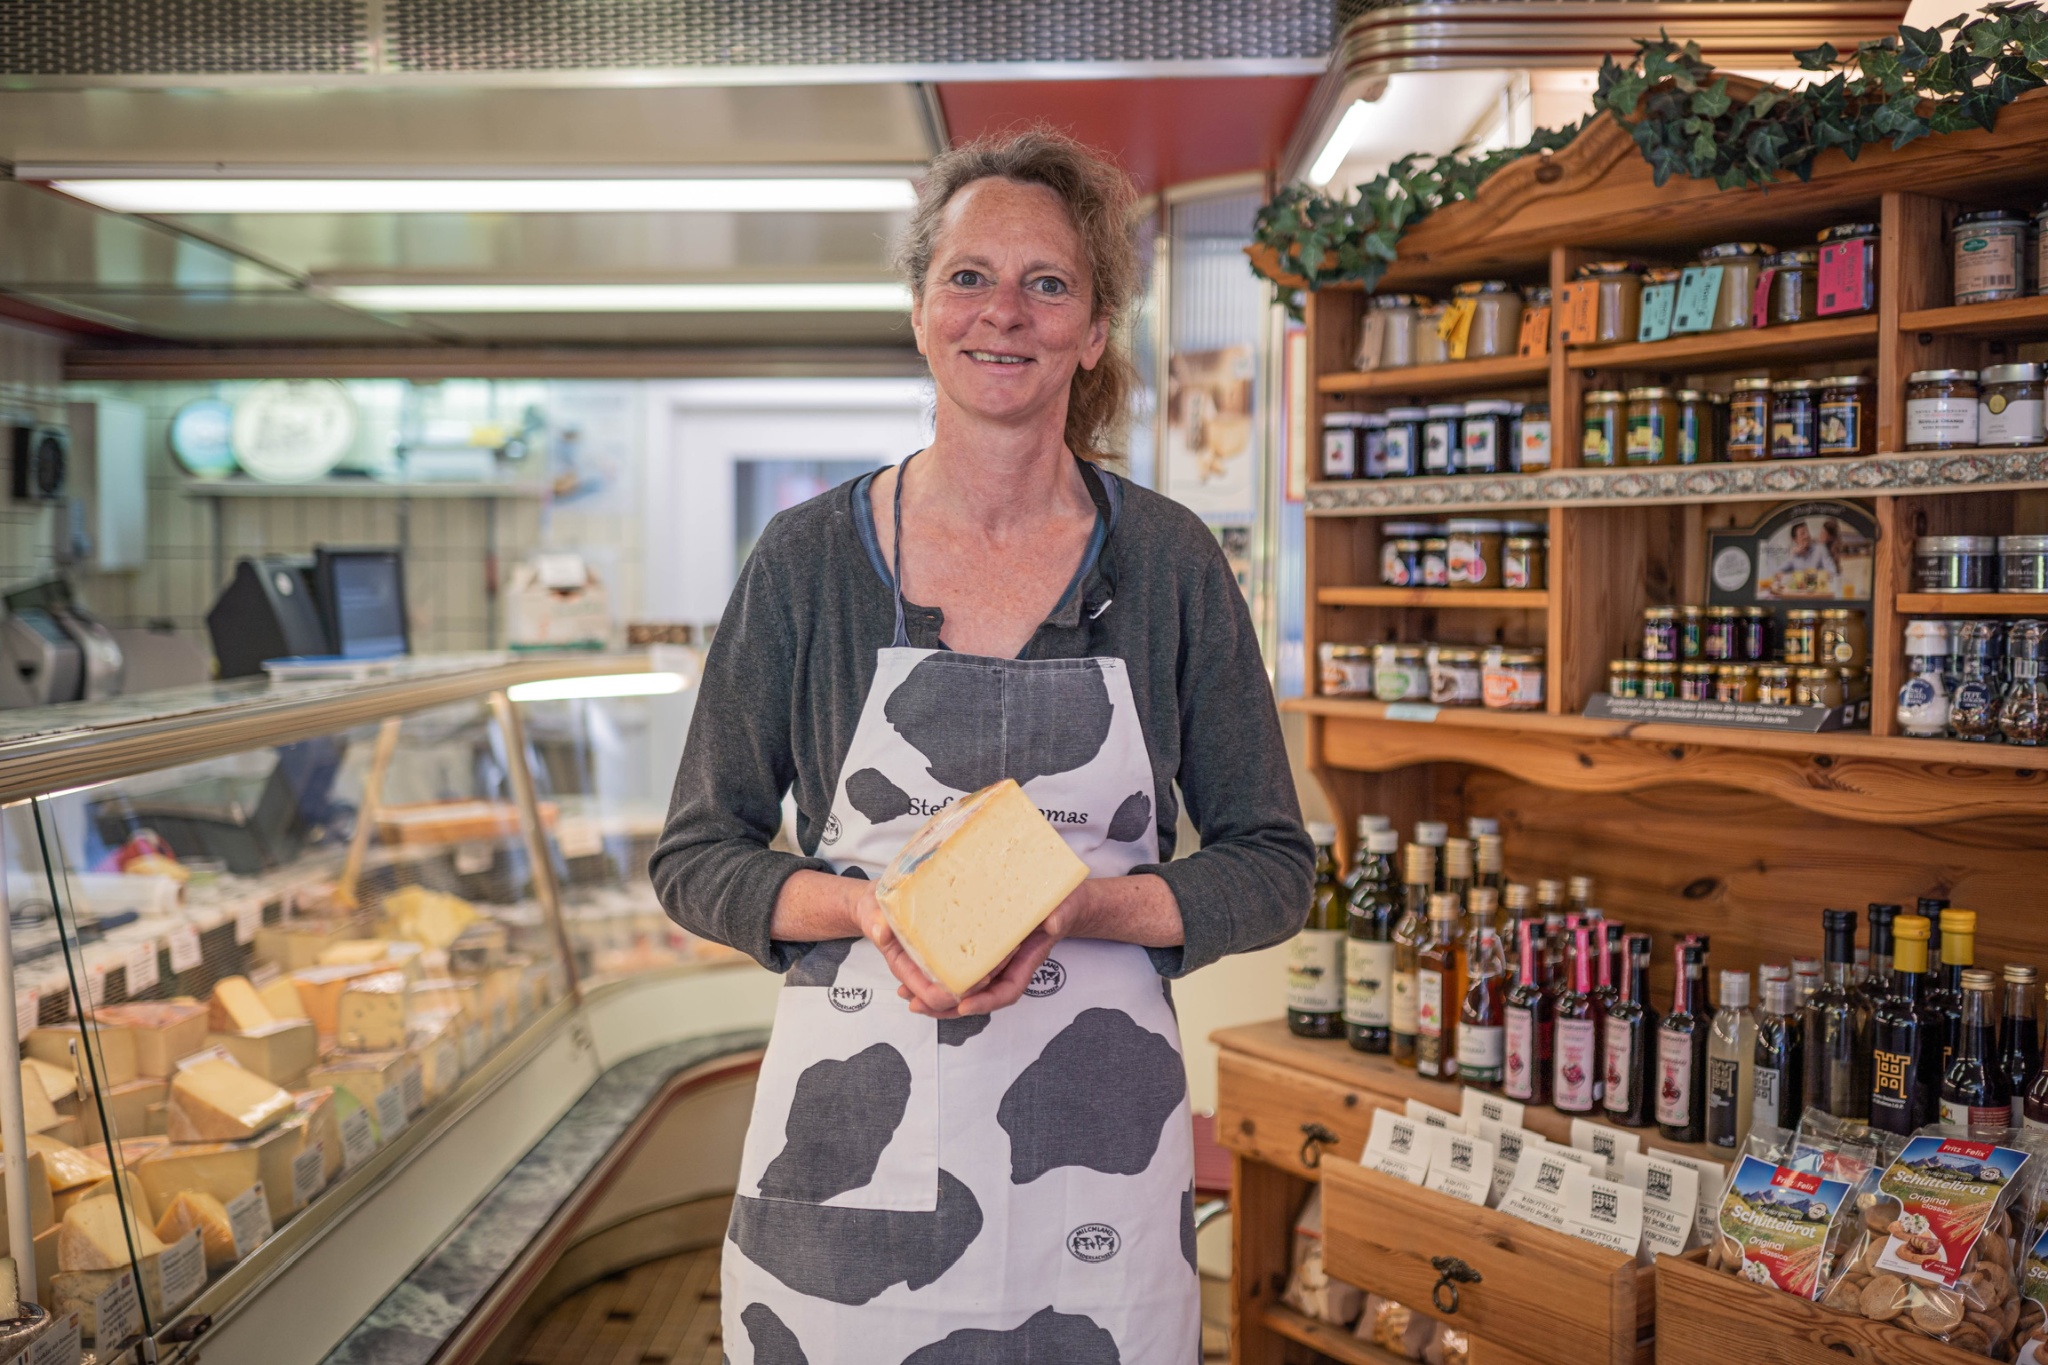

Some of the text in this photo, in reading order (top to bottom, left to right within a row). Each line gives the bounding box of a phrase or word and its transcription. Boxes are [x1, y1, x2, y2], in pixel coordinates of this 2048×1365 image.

[908, 796, 954, 817] Stef
[1042, 961, 1059, 971] LAND
[1943, 1144, 1986, 1157] Fritz Felix
[1797, 1180, 1815, 1191] Felix
[1893, 1170, 1990, 1196] Schüttelbrot
[1908, 1192, 1950, 1207] Original
[1921, 1202, 1953, 1215] classico
[1666, 1214, 1675, 1222] AI
[1731, 1205, 1817, 1238] Schüttelbrot
[1075, 1226, 1114, 1237] MILCHLAND
[1651, 1217, 1681, 1233] PORCINI
[1580, 1227, 1612, 1242] RISOTTO
[1749, 1235, 1785, 1252] Original
[1073, 1249, 1115, 1260] NIEDERSACHSEN
[1760, 1248, 1789, 1261] classico
